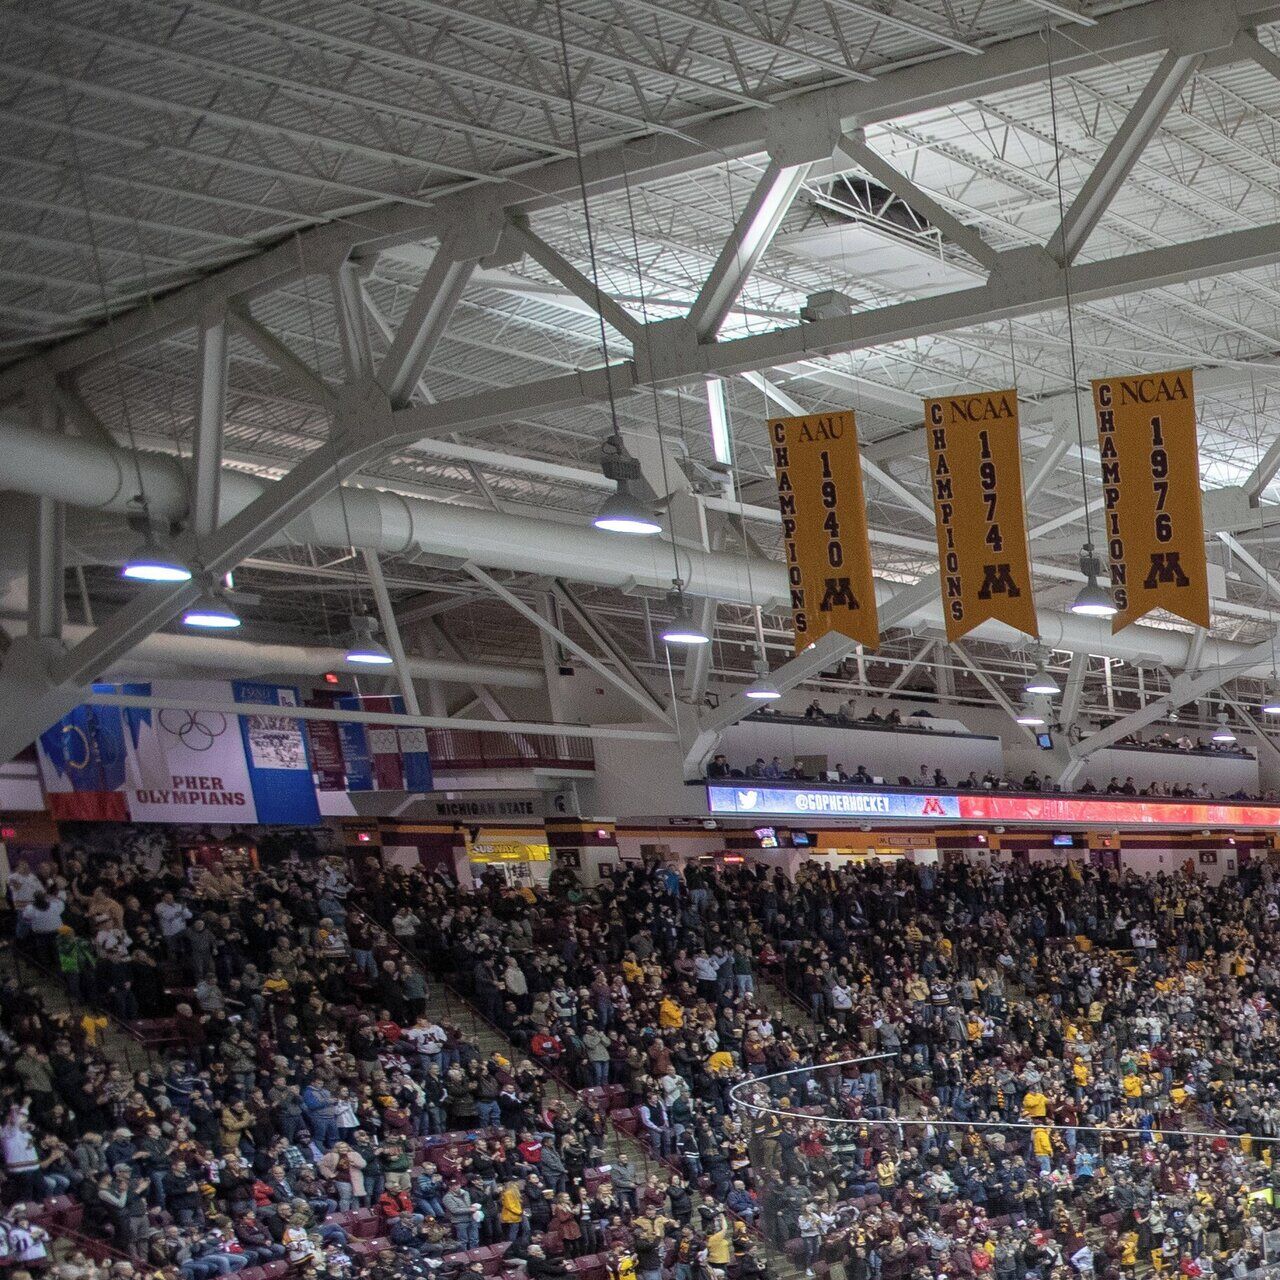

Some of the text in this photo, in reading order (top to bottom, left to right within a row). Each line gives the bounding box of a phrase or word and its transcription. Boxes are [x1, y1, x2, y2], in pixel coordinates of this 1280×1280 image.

[1118, 376, 1189, 406] NCAA
[949, 398, 1015, 424] NCAA
[796, 419, 845, 443] AAU
[977, 430, 1004, 553] 1974
[1149, 415, 1174, 543] 1976
[819, 450, 843, 569] 1940
[930, 402, 964, 622] CHAMPIONS
[1098, 384, 1129, 611] CHAMPIONS
[774, 422, 808, 634] CHAMPIONS
[977, 563, 1021, 600] M
[1143, 551, 1190, 590] M
[819, 577, 861, 611] M
[137, 789, 245, 805] OLYMPIANS
[172, 776, 224, 790] PHER
[437, 802, 533, 815] MICHIGAN STATE
[795, 794, 889, 812] @GOPHERHOCKEY
